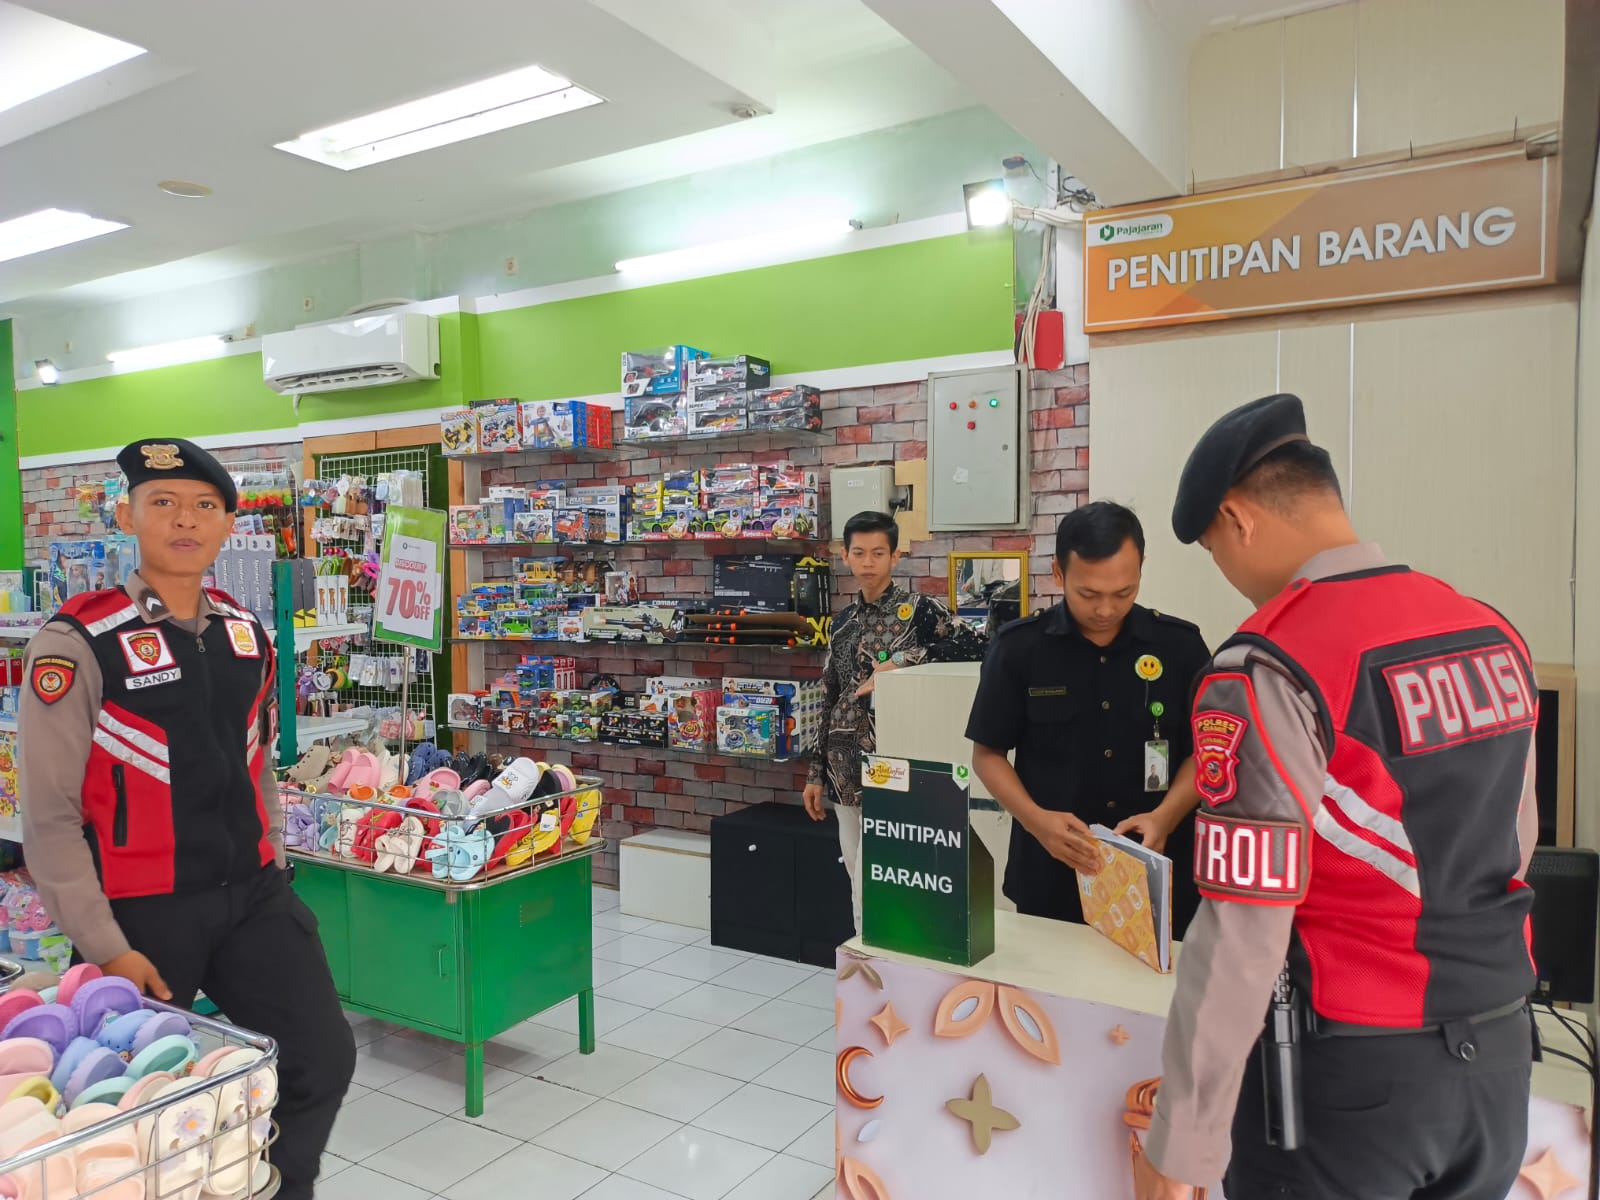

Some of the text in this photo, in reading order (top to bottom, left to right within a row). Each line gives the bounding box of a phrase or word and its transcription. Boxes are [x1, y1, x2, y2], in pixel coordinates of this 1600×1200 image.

[1117, 223, 1163, 236] Pajajaran
[1107, 206, 1517, 292] PENITIPAN BARANG
[386, 577, 432, 619] 70%
[414, 606, 430, 620] OFF
[132, 670, 178, 688] SANDY
[1394, 650, 1534, 743] POLISI
[863, 818, 961, 849] PENITIPAN
[871, 864, 953, 894] BARANG
